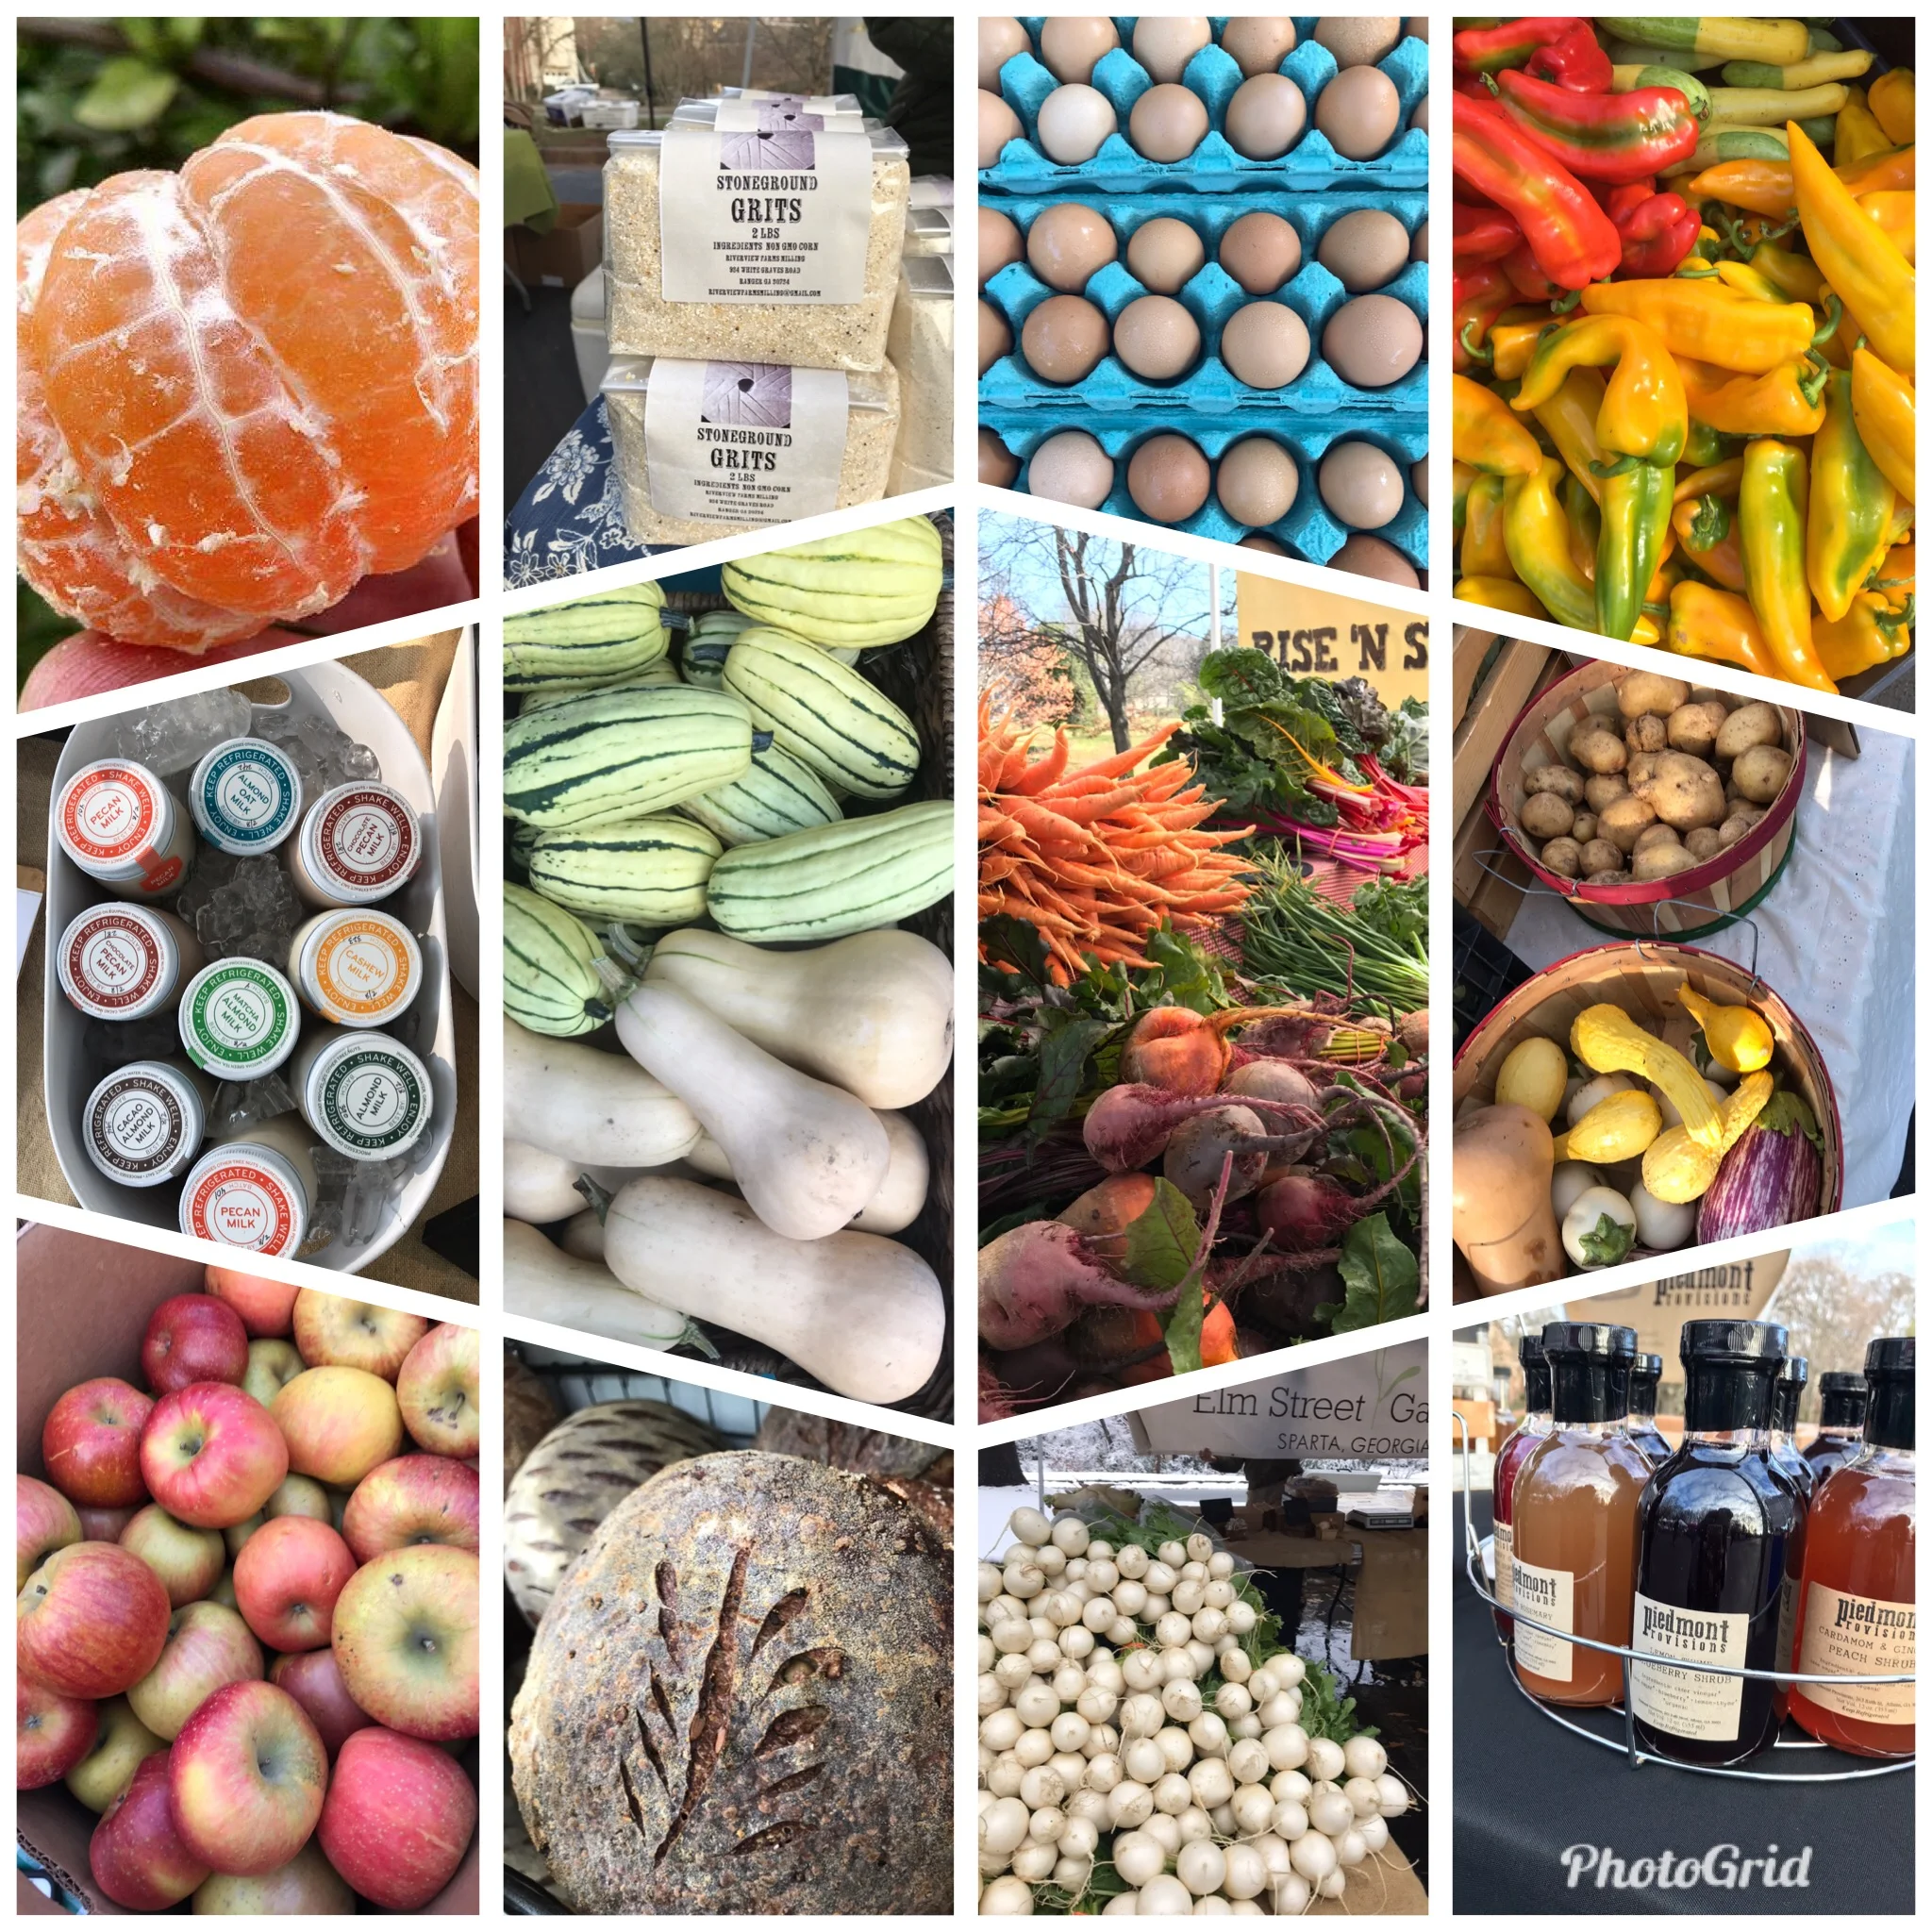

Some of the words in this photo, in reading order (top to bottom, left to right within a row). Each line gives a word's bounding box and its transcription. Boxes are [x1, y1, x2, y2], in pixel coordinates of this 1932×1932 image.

[717, 175, 818, 191] STONEGROUND
[731, 198, 803, 223] GRITS
[752, 228, 758, 239] 2
[760, 228, 779, 239] LBS
[713, 242, 762, 250] INGREDIENTS
[766, 242, 779, 251] NON
[782, 242, 797, 251] GMO
[799, 242, 819, 251] CORN
[697, 427, 792, 447] STONEGROUND
[710, 448, 776, 472] GRITS
[694, 479, 739, 490] INGREDIENTS
[730, 473, 736, 481] 2
[738, 474, 756, 482] LBS
[1252, 626, 1338, 673] RISE
[1404, 621, 1428, 670] S
[218, 752, 285, 779] REFRIGERATED
[110, 771, 140, 789] SHAKE
[207, 771, 218, 796] KEEP
[238, 774, 269, 805] ALMOND
[66, 773, 97, 841] REFRIGERATED
[137, 789, 150, 815] WELL
[230, 794, 251, 815] MILK
[240, 789, 256, 805] OAT
[274, 791, 289, 824] SHAKE
[354, 795, 389, 807] SHAKE
[91, 796, 121, 824] PECAN
[101, 807, 125, 829] MILK
[210, 809, 236, 835] ENJOY
[390, 806, 407, 831] WELL
[117, 827, 145, 852] ENJOY
[249, 824, 274, 838] WELL
[325, 803, 347, 875] REFRIGERATED
[347, 816, 371, 852] CHOCOLATE
[356, 824, 377, 855] PECAN
[80, 841, 104, 856] KEEP
[367, 834, 384, 857] MILK
[387, 844, 408, 874] ENJOY
[151, 866, 175, 885] PECAN
[158, 873, 175, 887] MILK
[349, 874, 375, 882] KEEP
[84, 919, 152, 946] REFRIGERATED
[326, 924, 399, 946] REFRIGERATED
[72, 936, 84, 960] KEEP
[106, 941, 135, 970] CHOCOLATE
[96, 958, 116, 979] MILK
[100, 948, 126, 975] PECAN
[319, 948, 328, 974] KEEP
[346, 950, 385, 978] CASHEW
[347, 964, 370, 982] MILK
[139, 958, 155, 992] SHAKE
[209, 971, 280, 999] REFRIGERATED
[393, 957, 406, 991] SHAKE
[75, 974, 99, 1001] ENJOY
[112, 991, 139, 1004] WELL
[195, 987, 209, 1012] KEEP
[325, 986, 355, 1009] ENJOY
[233, 993, 259, 1022] MATCHA
[370, 992, 394, 1009] WELL
[222, 1011, 242, 1033] MILK
[223, 997, 257, 1032] ALMOND
[197, 1026, 224, 1055] ENJOY
[266, 1012, 283, 1046] SHAKE
[237, 1045, 265, 1058] WELL
[358, 1055, 393, 1065] SHAKE
[133, 1080, 165, 1095] SHAKE
[395, 1063, 416, 1090] WELL
[165, 1096, 178, 1124] WELL
[327, 1064, 354, 1140] REFRIGERATED
[357, 1077, 382, 1121] ALMOND
[370, 1091, 388, 1116] MILK
[94, 1084, 121, 1157] REFRIGERATED
[117, 1104, 143, 1132] CACAO
[123, 1108, 154, 1143] ALMOND
[395, 1104, 416, 1136] ENJOY
[135, 1122, 156, 1144] MILK
[357, 1137, 384, 1145] KEEP
[112, 1156, 137, 1169] KEEP
[150, 1138, 176, 1165] ENJOY
[192, 1167, 257, 1215] REFRIGERATED
[265, 1181, 287, 1218] SHAKE
[221, 1208, 260, 1217] PECAN
[226, 1219, 255, 1228] MILK
[269, 1224, 287, 1252] WELL
[1193, 1388, 1258, 1416] Elm
[1269, 1387, 1365, 1421] Street
[1390, 1393, 1428, 1424] Ga
[1277, 1433, 1344, 1453] SPARTA,
[1351, 1437, 1428, 1454] GEORGIA
[1642, 1605, 1729, 1643] piedmont
[1819, 1625, 1874, 1650] CARDAMOM
[1880, 1641, 1887, 1650] &
[1829, 1644, 1867, 1663] PEACH
[1694, 1674, 1732, 1684] SHRUB
